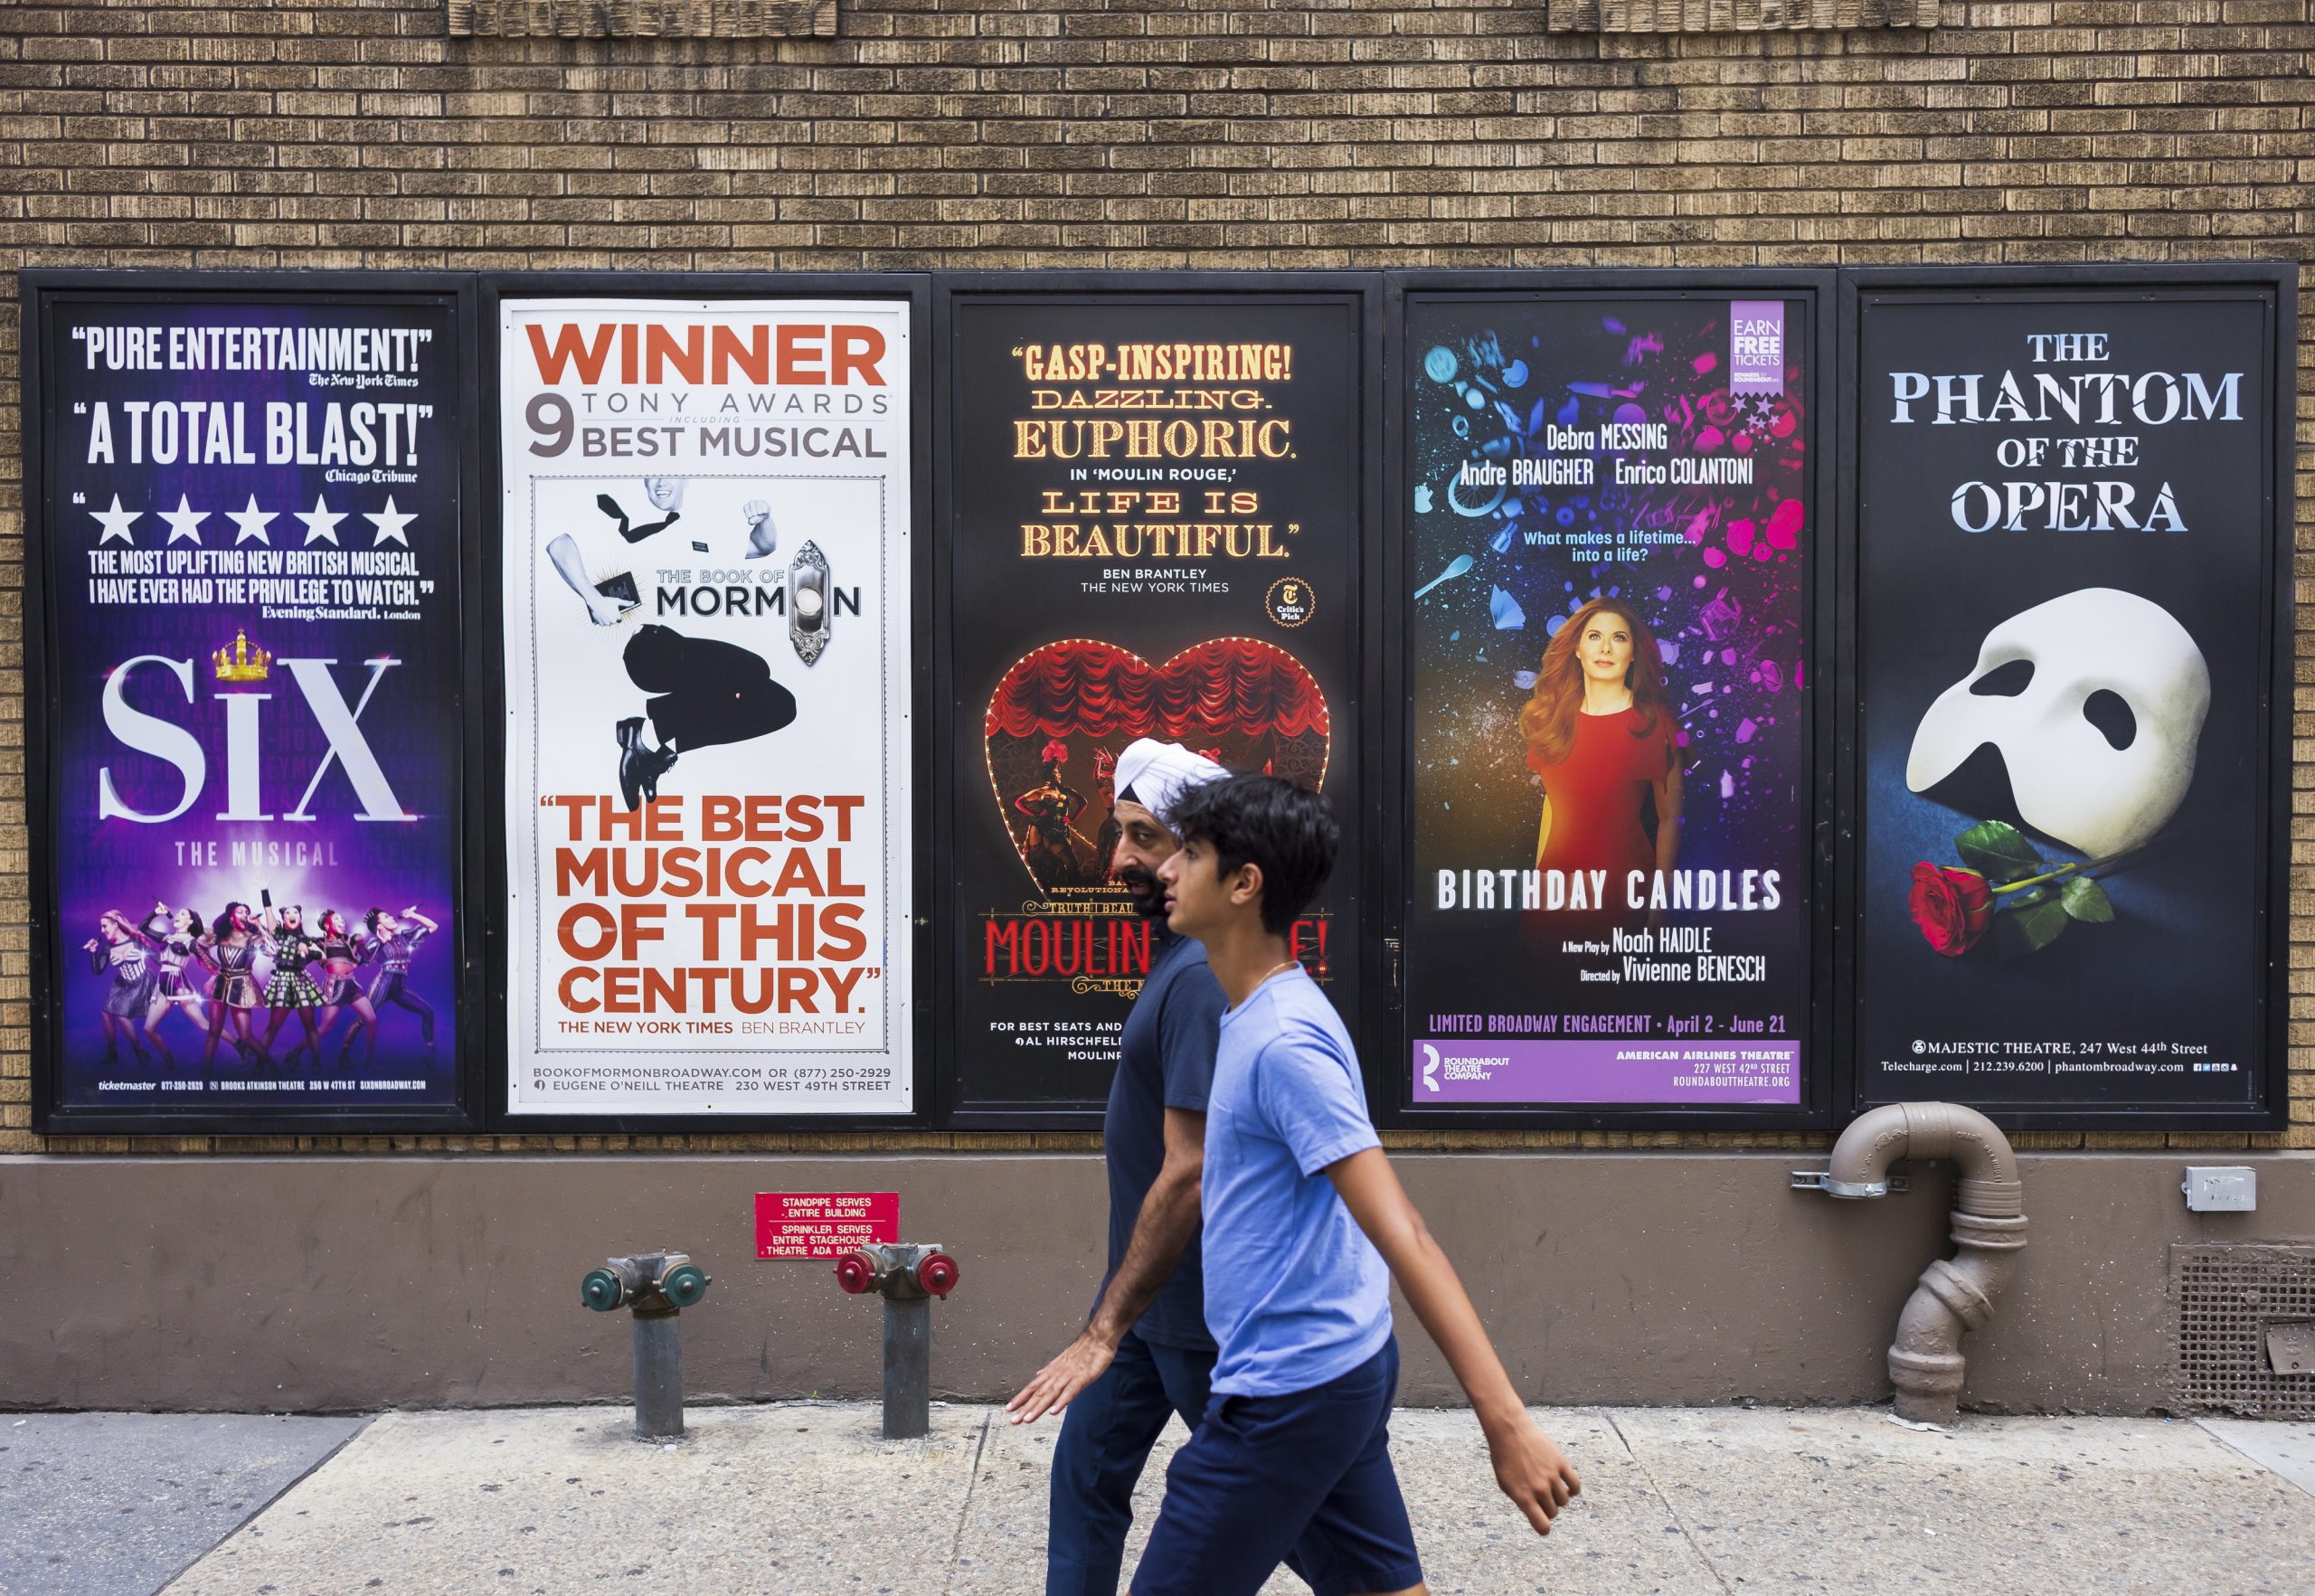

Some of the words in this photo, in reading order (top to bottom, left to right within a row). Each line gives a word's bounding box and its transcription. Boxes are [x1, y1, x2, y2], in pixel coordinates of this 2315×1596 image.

[1734, 320, 1780, 335] EARN
[72, 326, 162, 370] “PURE
[170, 327, 432, 372] ENTERTAINMENT!”
[1734, 336, 1780, 354] FREE
[2027, 333, 2110, 363] THE
[524, 323, 888, 386] WINNER
[1012, 345, 1291, 381] “GASP-INSPIRING!
[1734, 354, 1780, 366] TICKETS
[309, 373, 329, 387] The
[330, 373, 354, 386] New
[355, 373, 383, 390] York
[384, 373, 419, 387] Times
[1031, 390, 1272, 410] DAZZLING.
[1889, 370, 2244, 425] PHANTOM
[524, 392, 575, 458] 9
[581, 392, 689, 413] TONY
[721, 393, 888, 415] AWARDS
[669, 416, 741, 424] INCLUDING
[124, 401, 255, 465] TOTAL
[267, 402, 433, 467] BLAST!”
[582, 427, 685, 458] BEST
[700, 427, 887, 458] MUSICAL
[1014, 420, 1297, 458] EUPHORIC.
[1547, 424, 1594, 450] Debra
[1602, 423, 1668, 450] MESSING
[1997, 438, 2049, 467] OF
[2056, 436, 2139, 467] THE
[326, 469, 370, 484] Chicago
[372, 469, 418, 483] Tribune
[1070, 468, 1087, 481] IN
[1460, 459, 1507, 486] Andre
[1512, 459, 1593, 486] BRAUGHER
[1616, 458, 1666, 485] Enrico
[1671, 458, 1753, 485] COLANTONI
[1042, 491, 1180, 514] LIFE
[1205, 491, 1258, 514] IS
[1951, 481, 2188, 533] OPERA
[1021, 524, 1299, 557] BEAUTIFUL.”
[1524, 532, 1561, 544] What
[1565, 532, 1612, 544] makes
[89, 551, 118, 574] THE
[121, 551, 163, 574] MOST
[166, 551, 244, 575] UPLIFTING
[247, 552, 284, 575] NEW
[287, 552, 347, 575] BRITISH
[351, 552, 419, 576] MUSICAL
[1572, 550, 1600, 562] into
[1617, 548, 1649, 562] life?
[657, 570, 691, 583] THE
[700, 570, 753, 583] BOOK
[760, 570, 785, 583] OF
[1103, 569, 1130, 579] BEN
[1135, 569, 1207, 579] BRANTLEY
[98, 580, 137, 603] HAVE
[139, 580, 179, 604] EVER
[182, 580, 213, 604] HAD
[216, 580, 246, 604] THE
[249, 580, 328, 604] PRIVILEGE
[331, 581, 353, 605] TO
[355, 580, 434, 605] WATCH.”
[1081, 582, 1107, 593] THE
[1111, 582, 1143, 593] NEW
[1147, 582, 1185, 593] YORK
[1189, 582, 1229, 593] TIMES
[383, 610, 420, 619] London
[99, 655, 418, 824] SIX
[540, 795, 684, 842] “THE
[702, 794, 865, 842] BEST
[175, 842, 218, 866] THE
[232, 842, 338, 866] MUSICAL
[555, 846, 865, 897] MUSICAL
[1438, 869, 1607, 910] BIRTHDAY
[1627, 869, 1781, 910] CANDLES
[1049, 902, 1091, 913] TRUTH
[557, 902, 667, 961] OF
[685, 902, 867, 962] THIS
[1613, 927, 1653, 953] Noah
[1659, 927, 1712, 953] HAIDLE
[986, 920, 1150, 976] MOULIN
[1581, 969, 1611, 982] Directed
[1623, 956, 1691, 981] Vivienne
[1697, 956, 1765, 982] BENESCH
[558, 966, 880, 1014] CENTURY.”
[558, 1021, 590, 1034] THE
[594, 1021, 632, 1034] NEW
[637, 1021, 682, 1034] YORK
[685, 1022, 733, 1034] TIMES
[742, 1022, 774, 1034] BEN
[780, 1022, 865, 1034] BRANTLEY
[990, 1022, 1015, 1031] FOR
[1019, 1022, 1050, 1031] BEST
[1054, 1022, 1091, 1031] SEATS
[1096, 1022, 1122, 1031] AND
[1430, 1015, 1482, 1033] LIMITED
[1488, 1015, 1557, 1033] BROADWAY
[1564, 1015, 1651, 1033] ENGAGEMENT
[1668, 1015, 1699, 1037] April
[1730, 1015, 1763, 1033] June
[1770, 1015, 1786, 1033] 21
[1616, 1051, 1678, 1060] AMERICAN
[1683, 1051, 1736, 1060] AIRLINES
[1928, 1043, 1999, 1053] MAJESTIC
[2003, 1043, 2076, 1055] THEATRE,
[2080, 1044, 2102, 1053] 247
[2107, 1044, 2137, 1054] West
[2141, 1042, 2167, 1054] 44th
[2171, 1043, 2208, 1054] Street
[1444, 1057, 1509, 1066] ROUNDABOUT
[1695, 1063, 1710, 1073] 227
[1715, 1063, 1736, 1073] WEST
[1761, 1063, 1791, 1073] STREET
[1881, 1061, 1962, 1073] Telecharge.com
[1973, 1062, 2044, 1072] 212.239.6200
[2055, 1062, 2184, 1074] phantombroadway.com
[534, 1068, 761, 1078] BOOKOFMORMONBROADWAY.COM
[769, 1069, 788, 1078] OR
[794, 1068, 827, 1079] (877)
[830, 1069, 891, 1078] 250-2929
[1674, 1076, 1790, 1087] ROUNDABOUTTHEATRE.ORG
[99, 1081, 156, 1091] ticketmaster
[360, 1080, 426, 1091] SIXONBROADWAY.COM
[553, 1081, 606, 1091] EUGENE
[610, 1081, 660, 1091] O’NEILL
[665, 1081, 723, 1091] THEATRE
[735, 1081, 759, 1091] 230
[763, 1081, 800, 1091] WEST
[804, 1081, 837, 1091] 49TH
[842, 1081, 891, 1091] STREET
[782, 1198, 831, 1207] STANDPIPE
[836, 1198, 872, 1207] SERVES
[789, 1209, 820, 1217] ENTIRE
[825, 1209, 866, 1217] BUILDING
[781, 1225, 832, 1233] SPRINKLER
[836, 1225, 873, 1233] SERVES
[772, 1236, 805, 1244] ENTIRE
[809, 1235, 871, 1244] STAGEHOUSE
[767, 1246, 808, 1255] THEATRE
[813, 1246, 832, 1255] ADA
